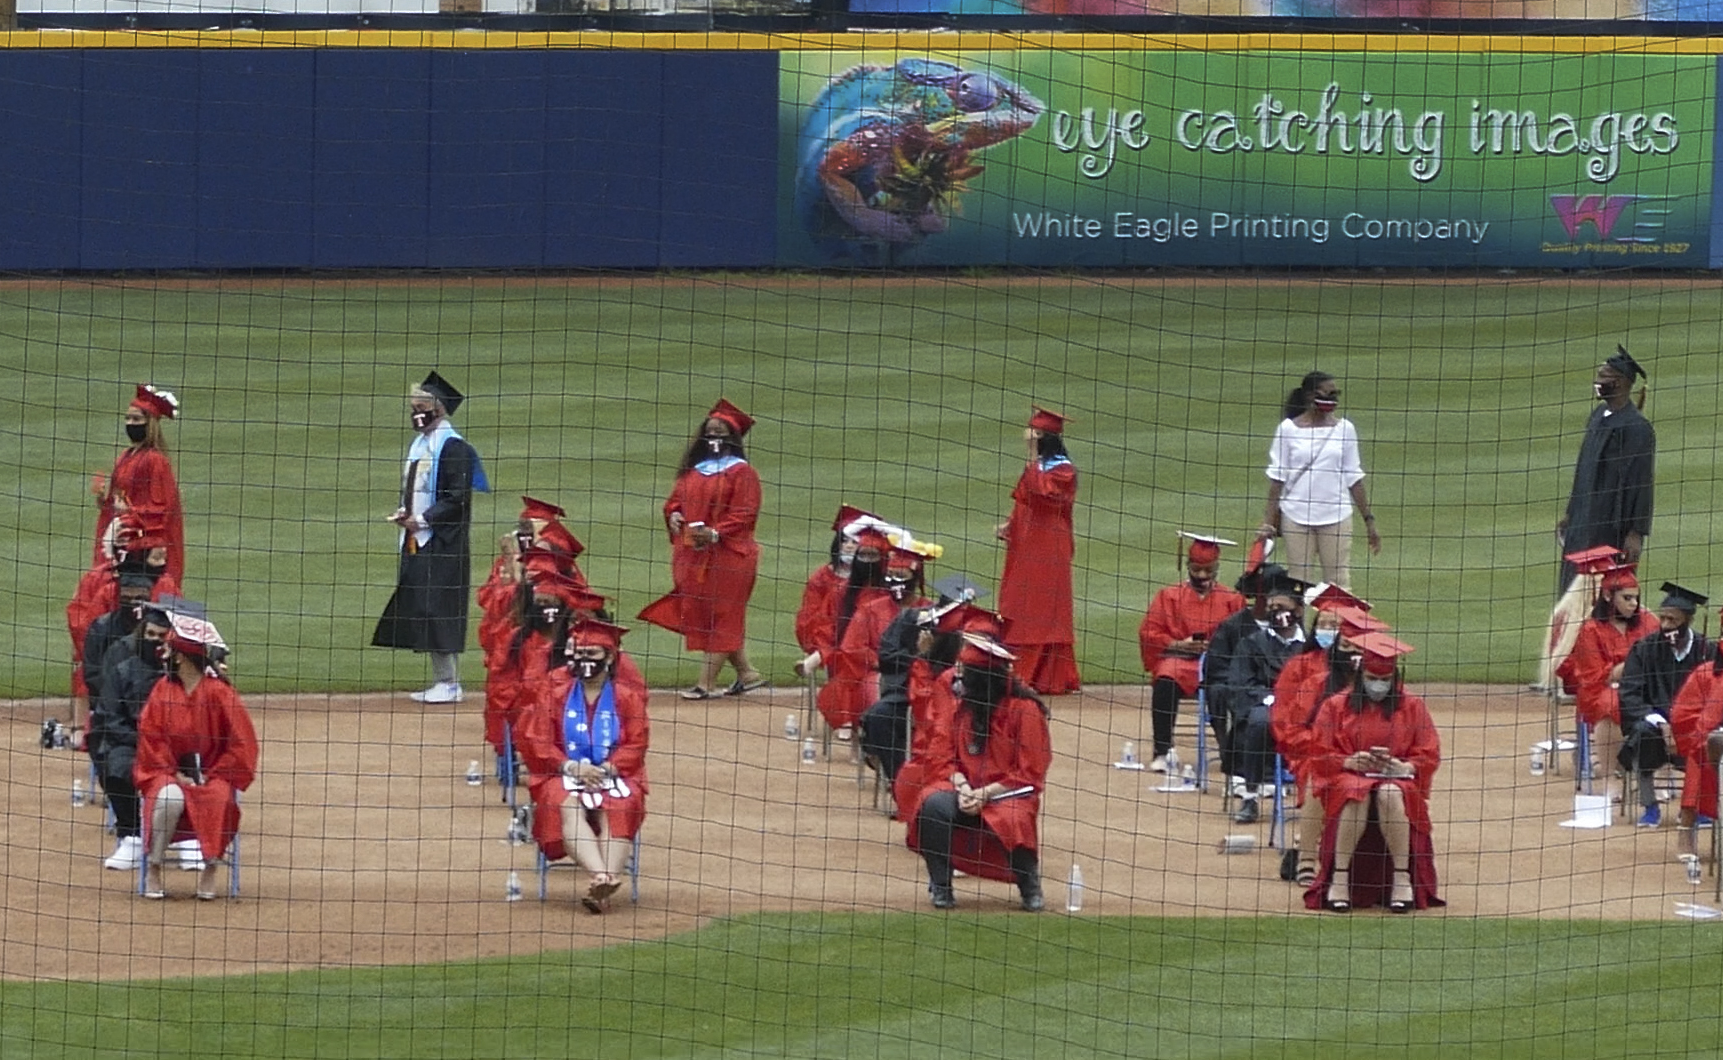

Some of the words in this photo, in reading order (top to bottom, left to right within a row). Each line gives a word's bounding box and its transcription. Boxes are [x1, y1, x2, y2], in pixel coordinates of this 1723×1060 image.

[1052, 106, 1151, 180] eye
[1177, 80, 1446, 183] catching
[1471, 98, 1680, 183] images
[1013, 211, 1103, 239] White
[1113, 211, 1199, 243] Eagle
[1210, 211, 1330, 244] Printing
[1341, 212, 1490, 244] Company
